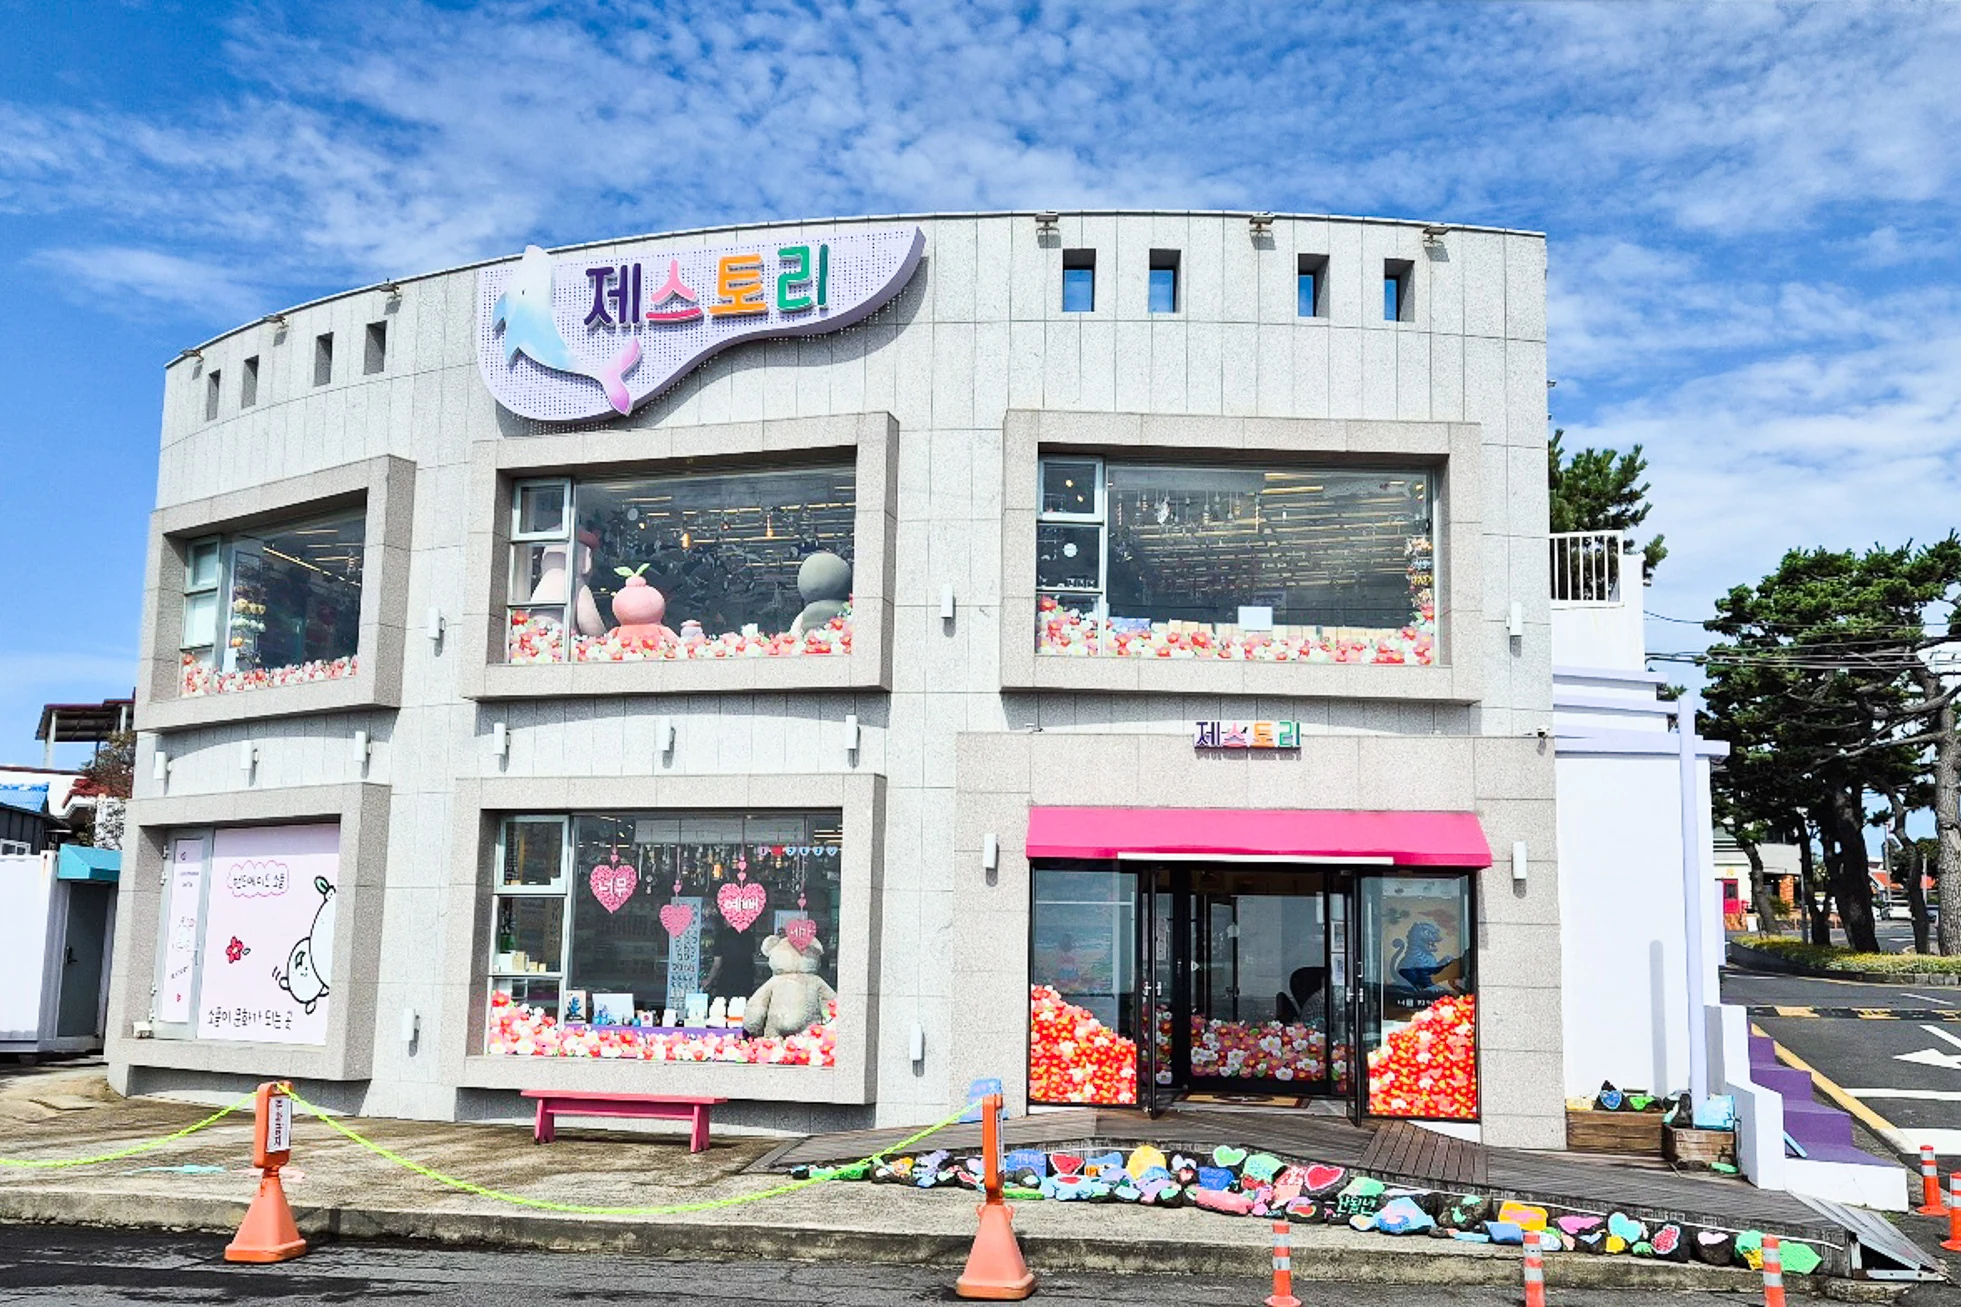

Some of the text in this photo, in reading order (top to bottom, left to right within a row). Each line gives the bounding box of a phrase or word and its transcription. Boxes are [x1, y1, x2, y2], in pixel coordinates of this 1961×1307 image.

[583, 243, 830, 328] 제스토리
[1194, 719, 1301, 749] 제스토리
[598, 877, 628, 899] 너무
[723, 896, 760, 912] 예뻐
[207, 1006, 293, 1031] 소품이 문화가 되는 곳
